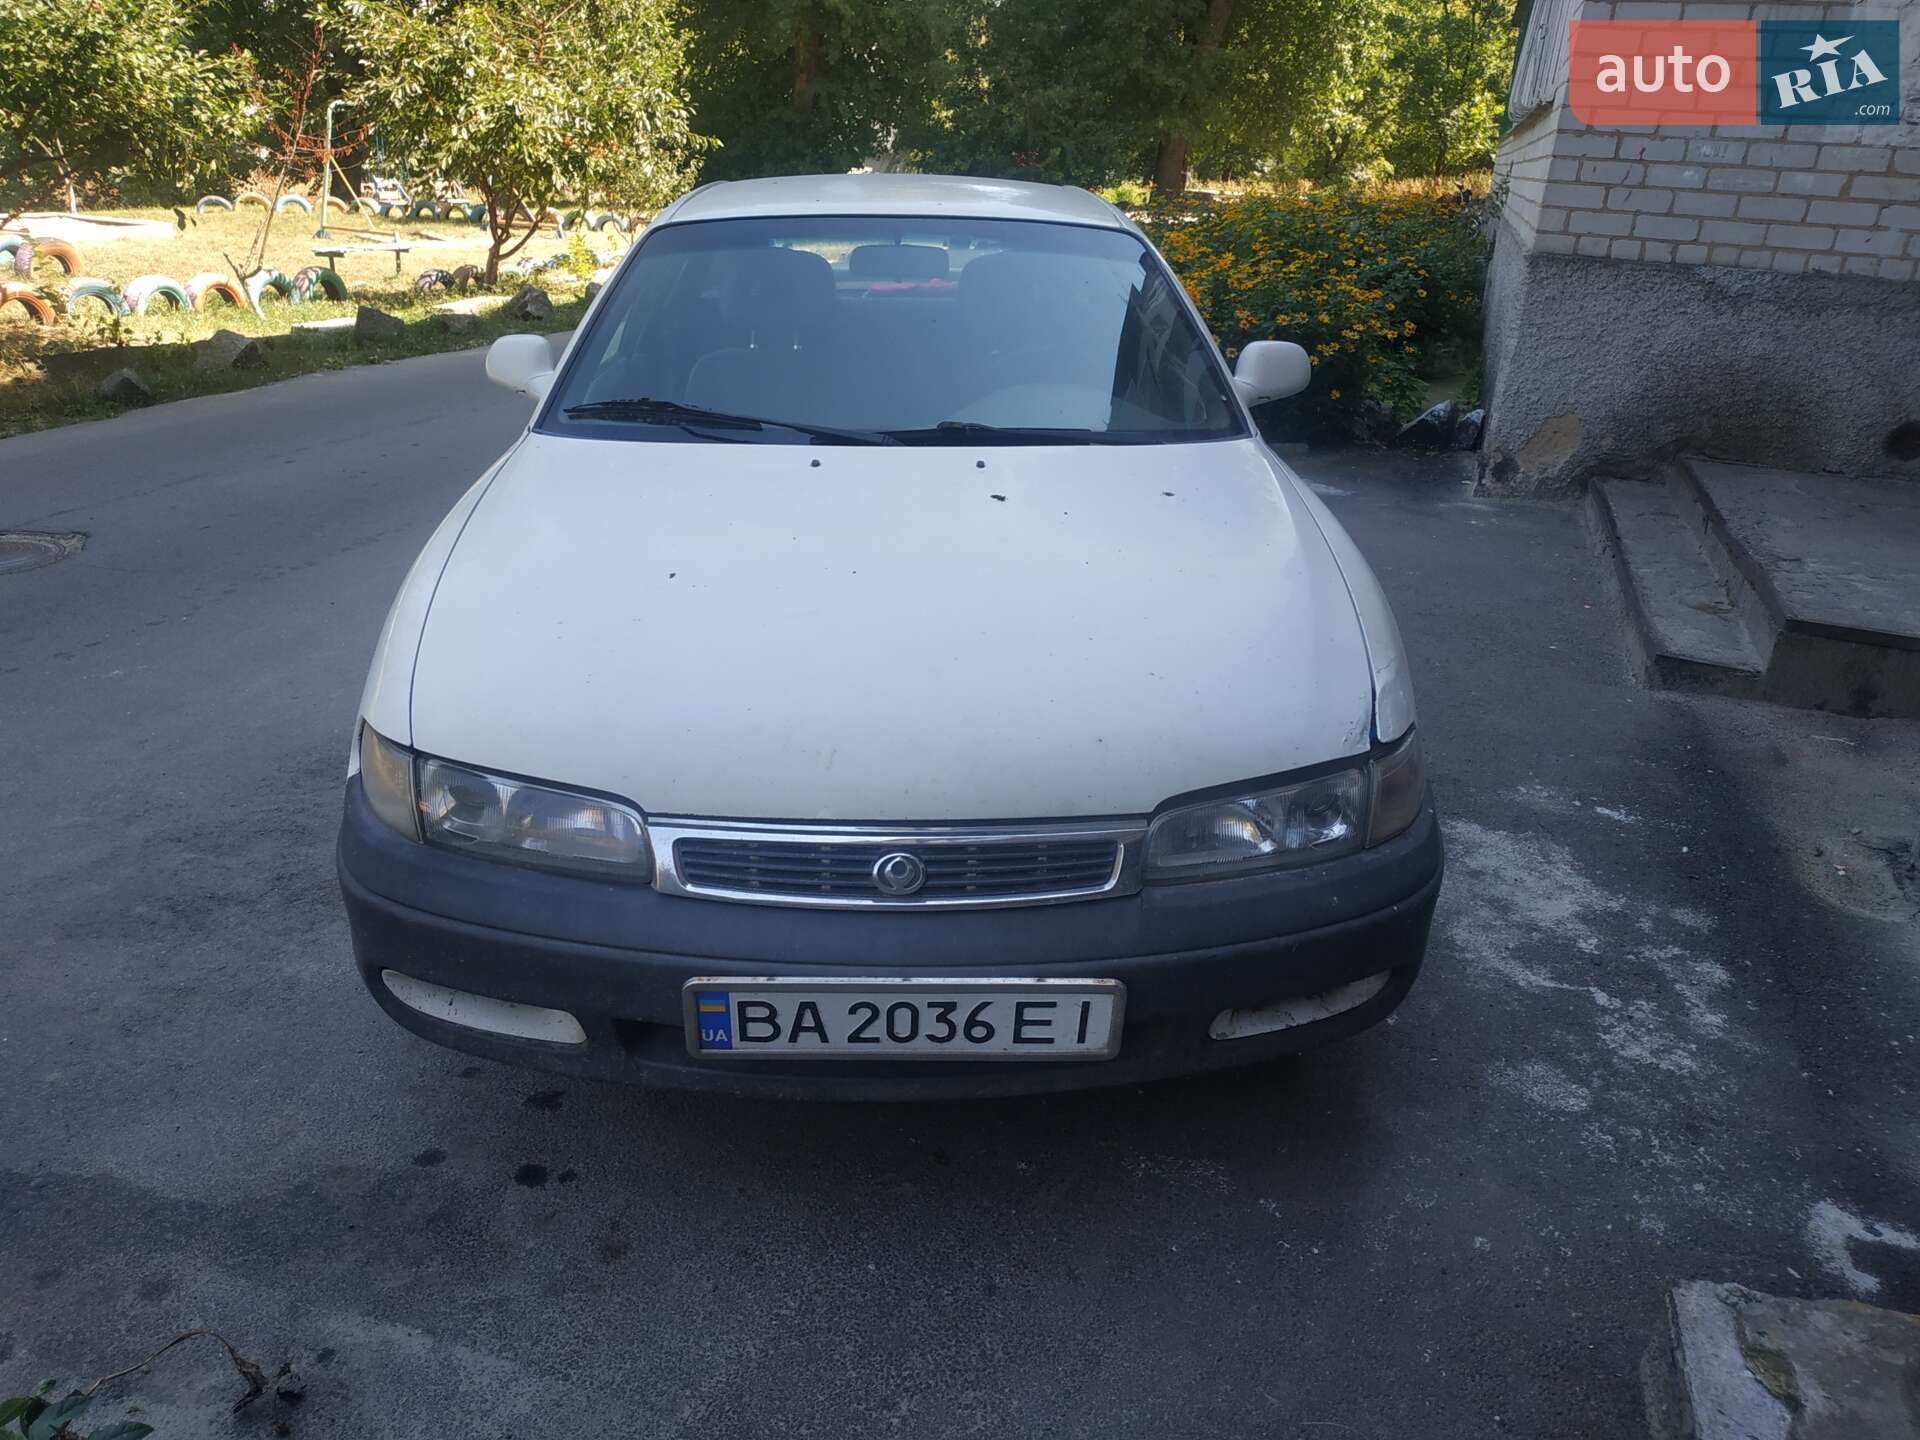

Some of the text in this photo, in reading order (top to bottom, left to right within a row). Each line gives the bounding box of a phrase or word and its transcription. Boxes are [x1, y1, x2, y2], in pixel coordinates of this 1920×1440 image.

[702, 1029, 728, 1043] UA
[737, 1000, 1092, 1045] BA 2036 EI
